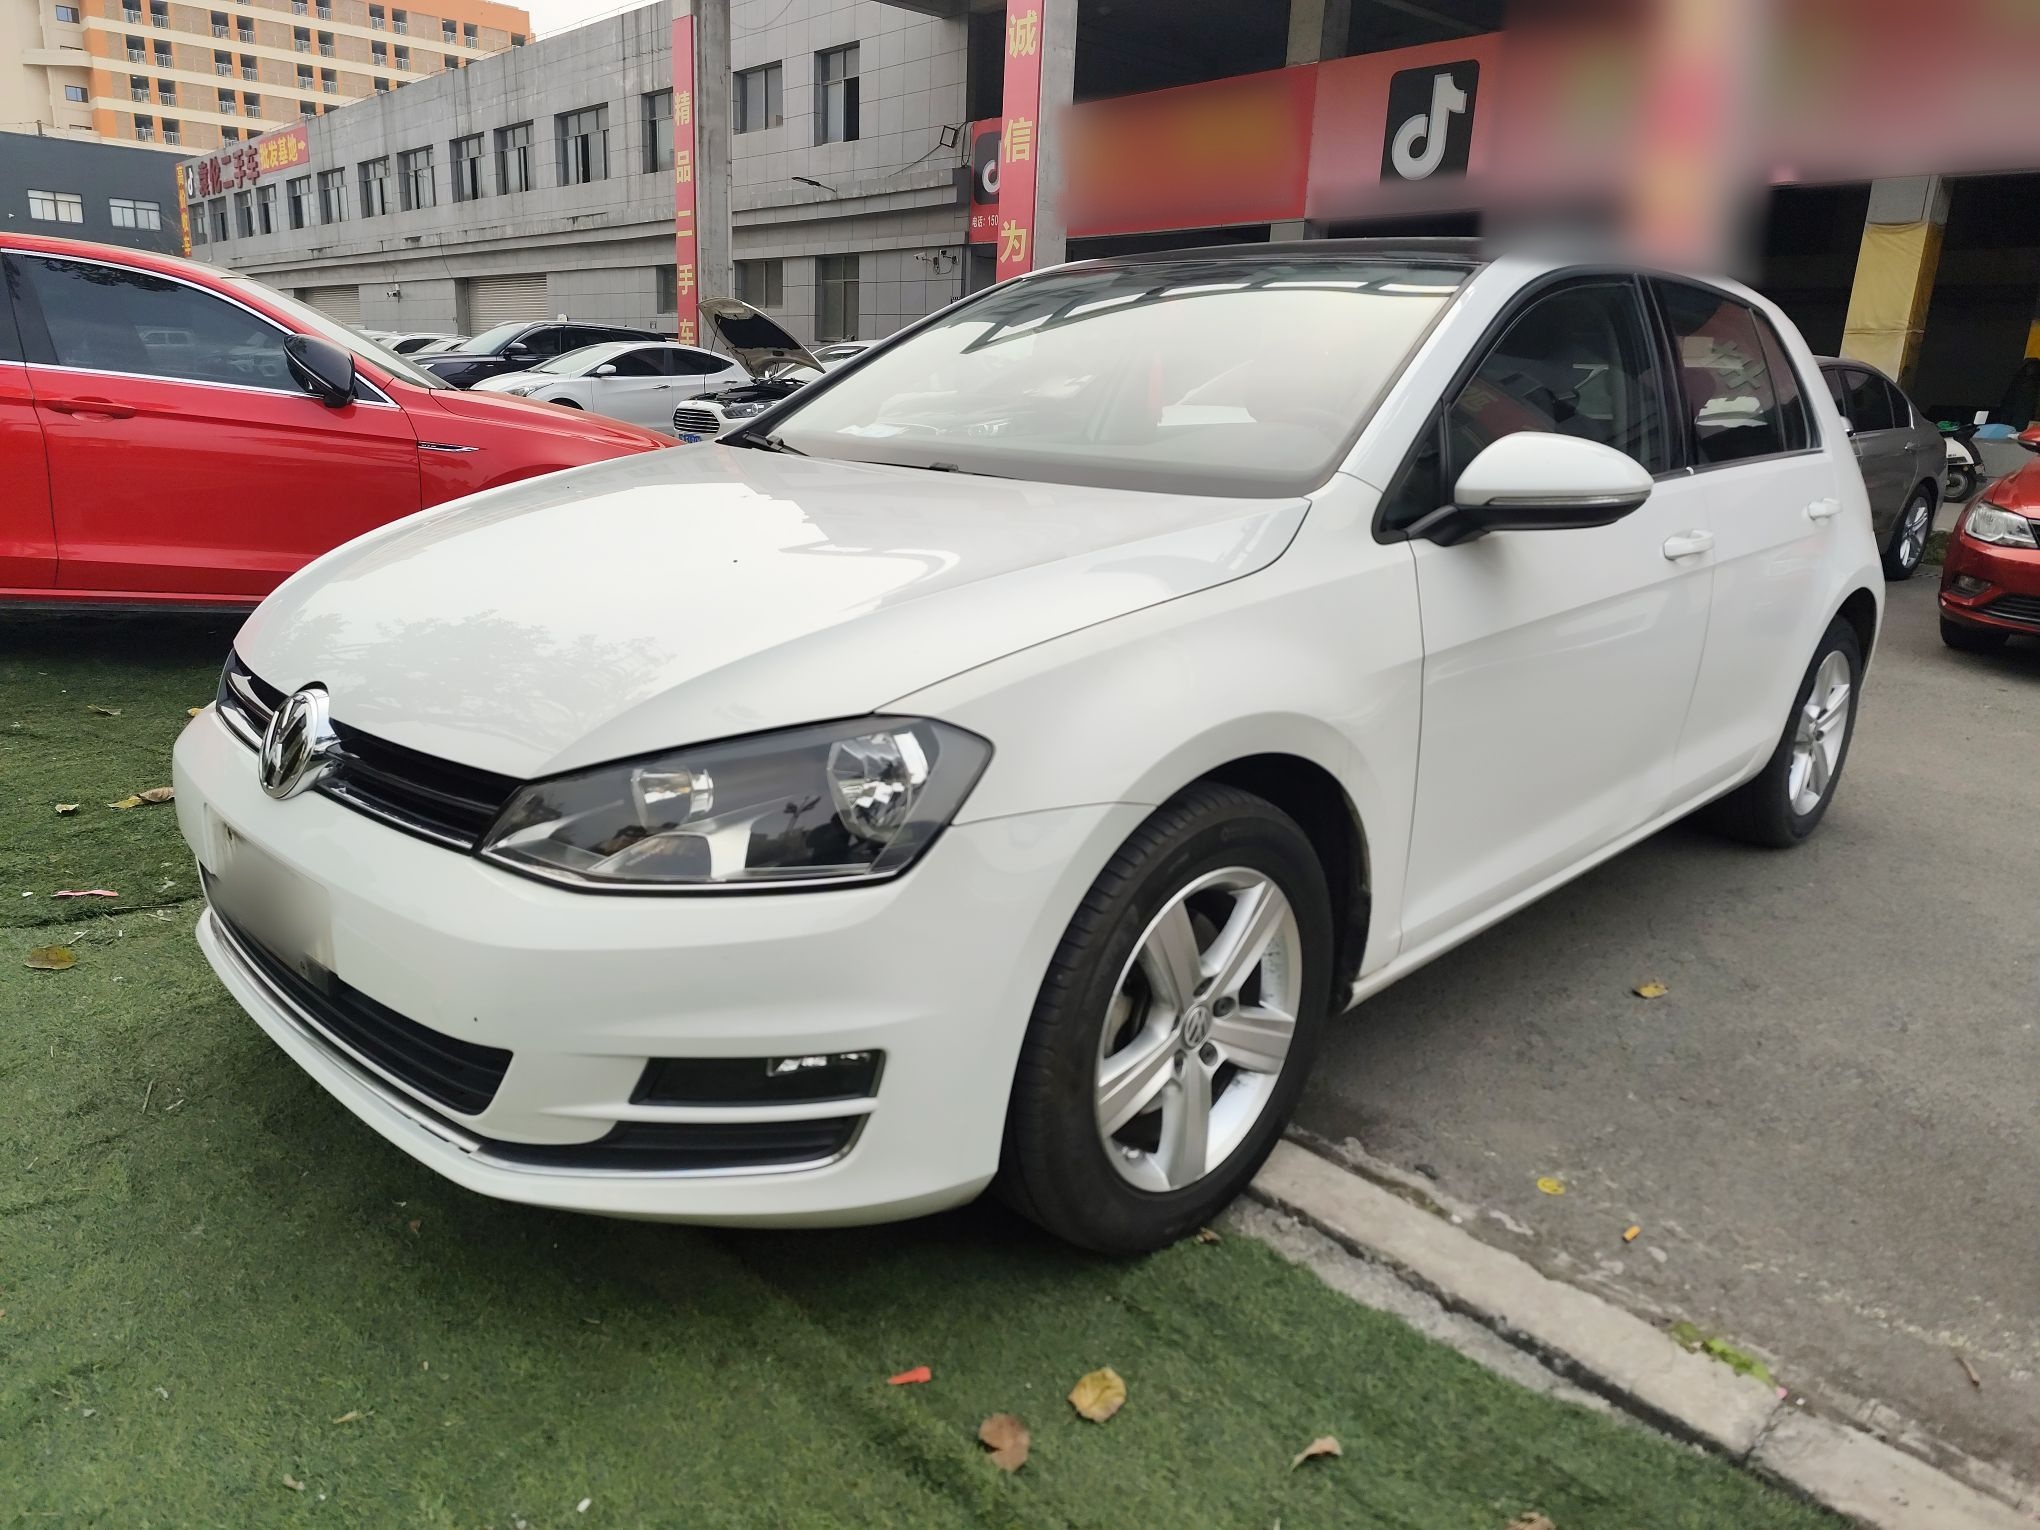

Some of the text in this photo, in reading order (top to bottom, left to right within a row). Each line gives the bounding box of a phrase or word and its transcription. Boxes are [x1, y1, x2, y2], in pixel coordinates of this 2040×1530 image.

[674, 91, 694, 345] 精品二手车
[1000, 10, 1038, 263] 诚信为
